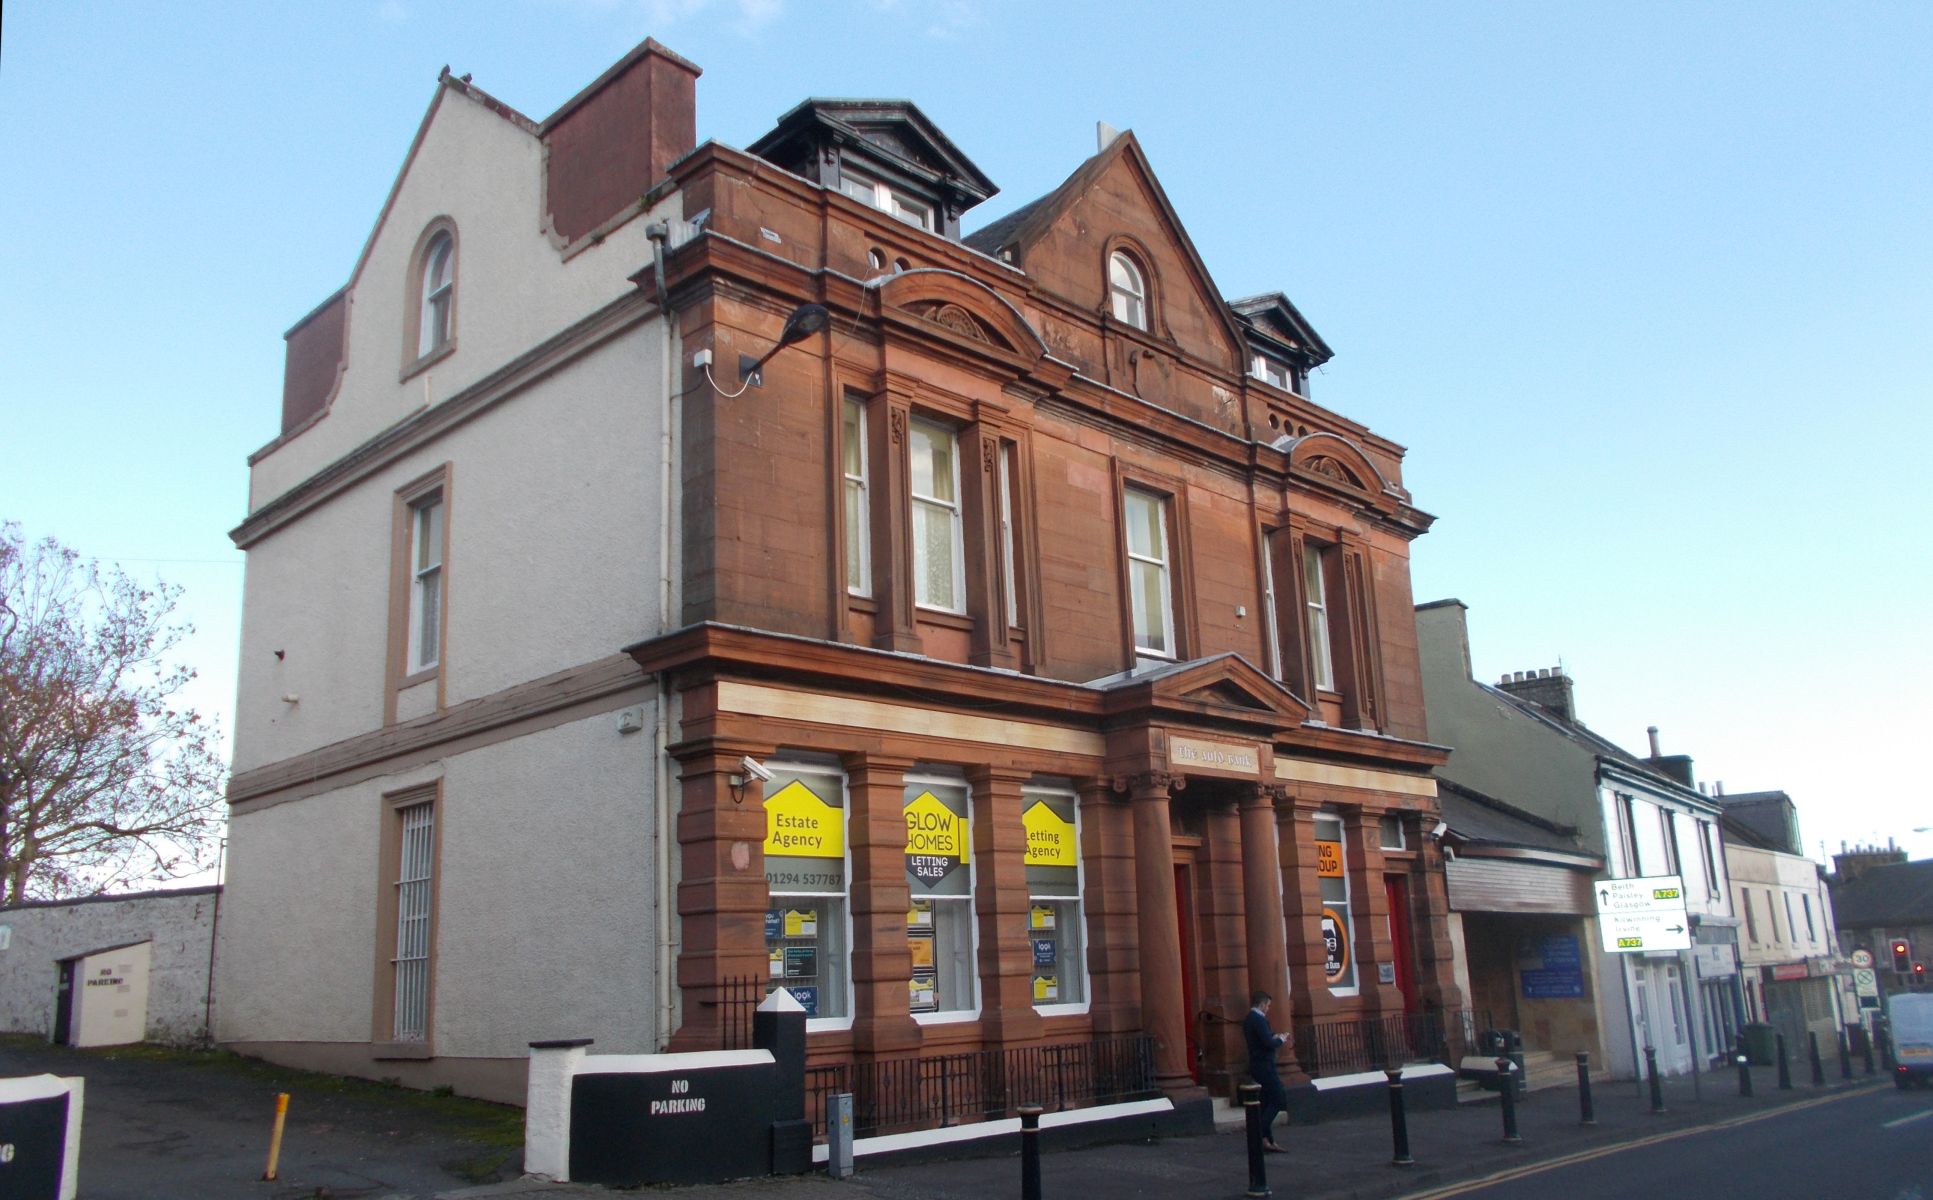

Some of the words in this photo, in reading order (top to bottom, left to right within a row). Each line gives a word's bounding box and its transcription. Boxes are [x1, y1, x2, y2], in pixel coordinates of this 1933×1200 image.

[776, 813, 818, 829] Estate
[905, 811, 952, 832] GLOW
[772, 831, 822, 849] Agency
[1025, 844, 1061, 859] Agency
[911, 856, 948, 867] LETTING
[1317, 860, 1338, 872] OUP
[917, 866, 944, 877] SALES
[766, 872, 799, 885] 01294
[803, 873, 842, 886] 537787
[1611, 883, 1634, 891] Beith
[1612, 892, 1644, 900] Paisley
[1654, 889, 1678, 899] A737
[1613, 901, 1651, 909] Glasgow
[1618, 938, 1641, 947] A737
[1855, 954, 1869, 963] 30
[671, 1080, 689, 1094] NO
[651, 1098, 706, 1115] PARKING
